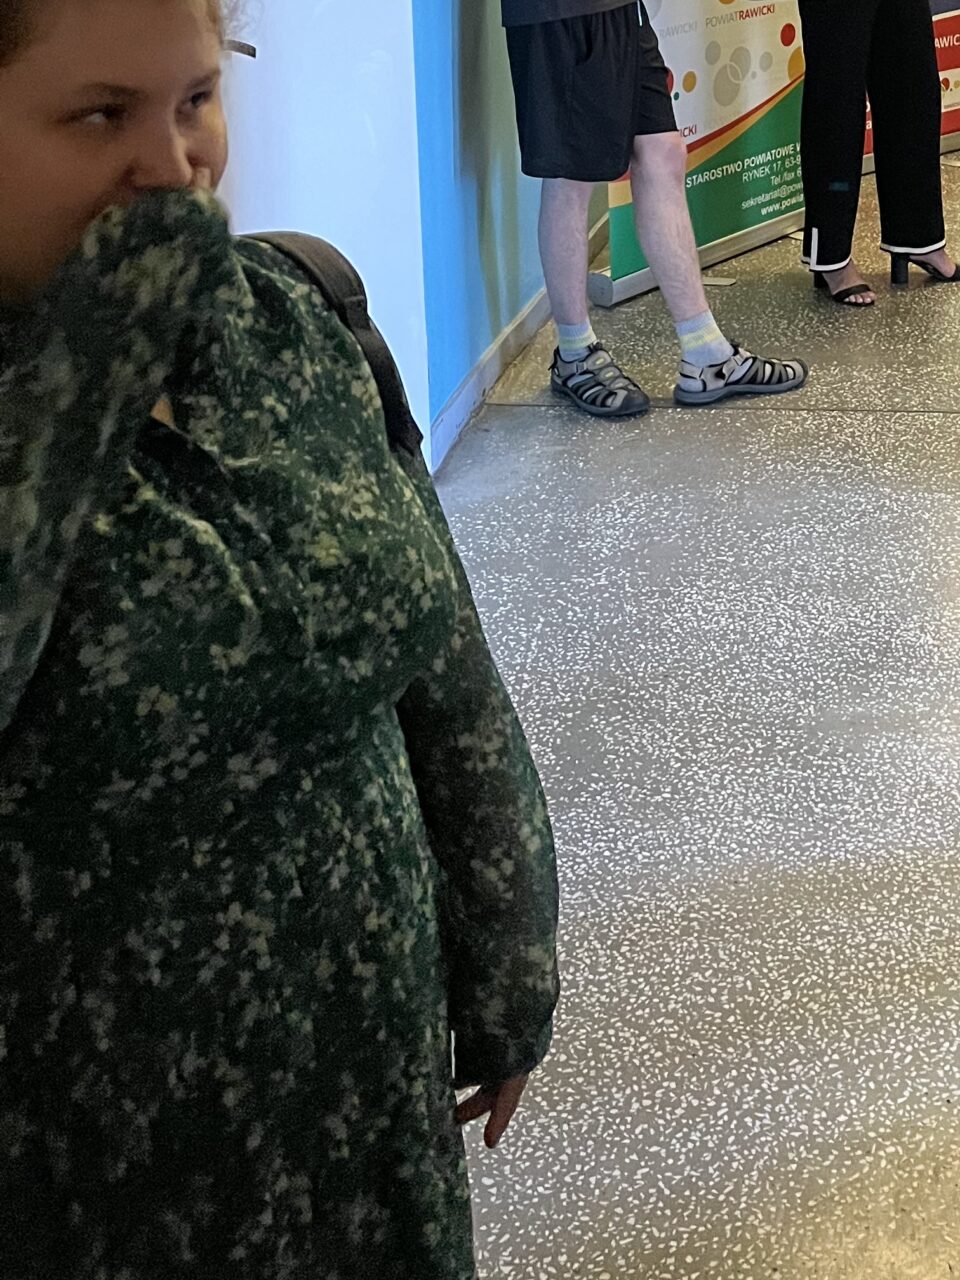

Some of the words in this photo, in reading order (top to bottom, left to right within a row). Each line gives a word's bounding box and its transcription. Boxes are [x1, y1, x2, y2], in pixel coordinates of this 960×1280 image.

[686, 161, 742, 188] STAROSTWO
[744, 143, 795, 169] POWIATOWE
[742, 164, 770, 182] RYNEK
[785, 154, 802, 169] 63-9
[796, 165, 802, 178] 6
